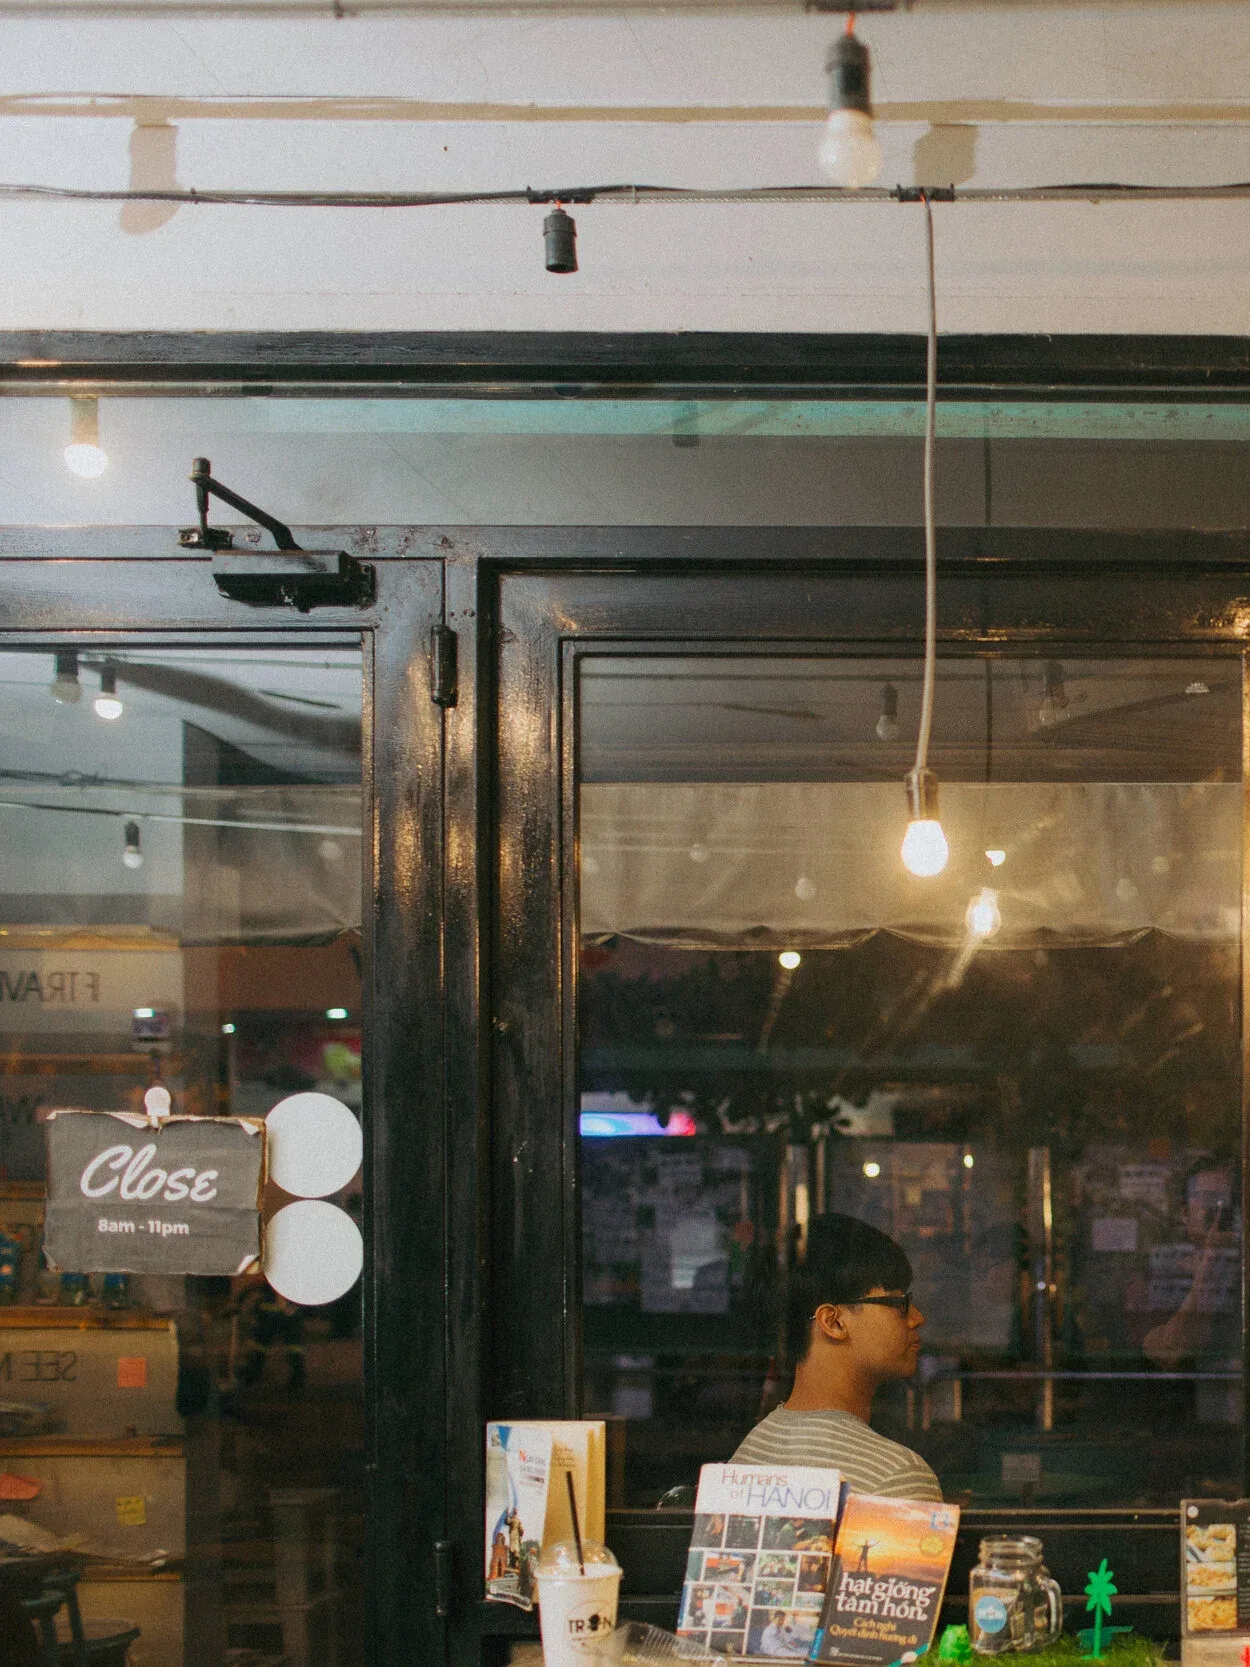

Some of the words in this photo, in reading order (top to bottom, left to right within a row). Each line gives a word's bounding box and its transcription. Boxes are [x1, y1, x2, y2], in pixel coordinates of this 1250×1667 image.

[79, 1143, 219, 1203] Close
[98, 1218, 136, 1234] 8am
[148, 1219, 190, 1237] 11pm
[721, 1466, 789, 1488] Humans
[730, 1487, 744, 1500] of
[746, 1484, 832, 1511] HANOI
